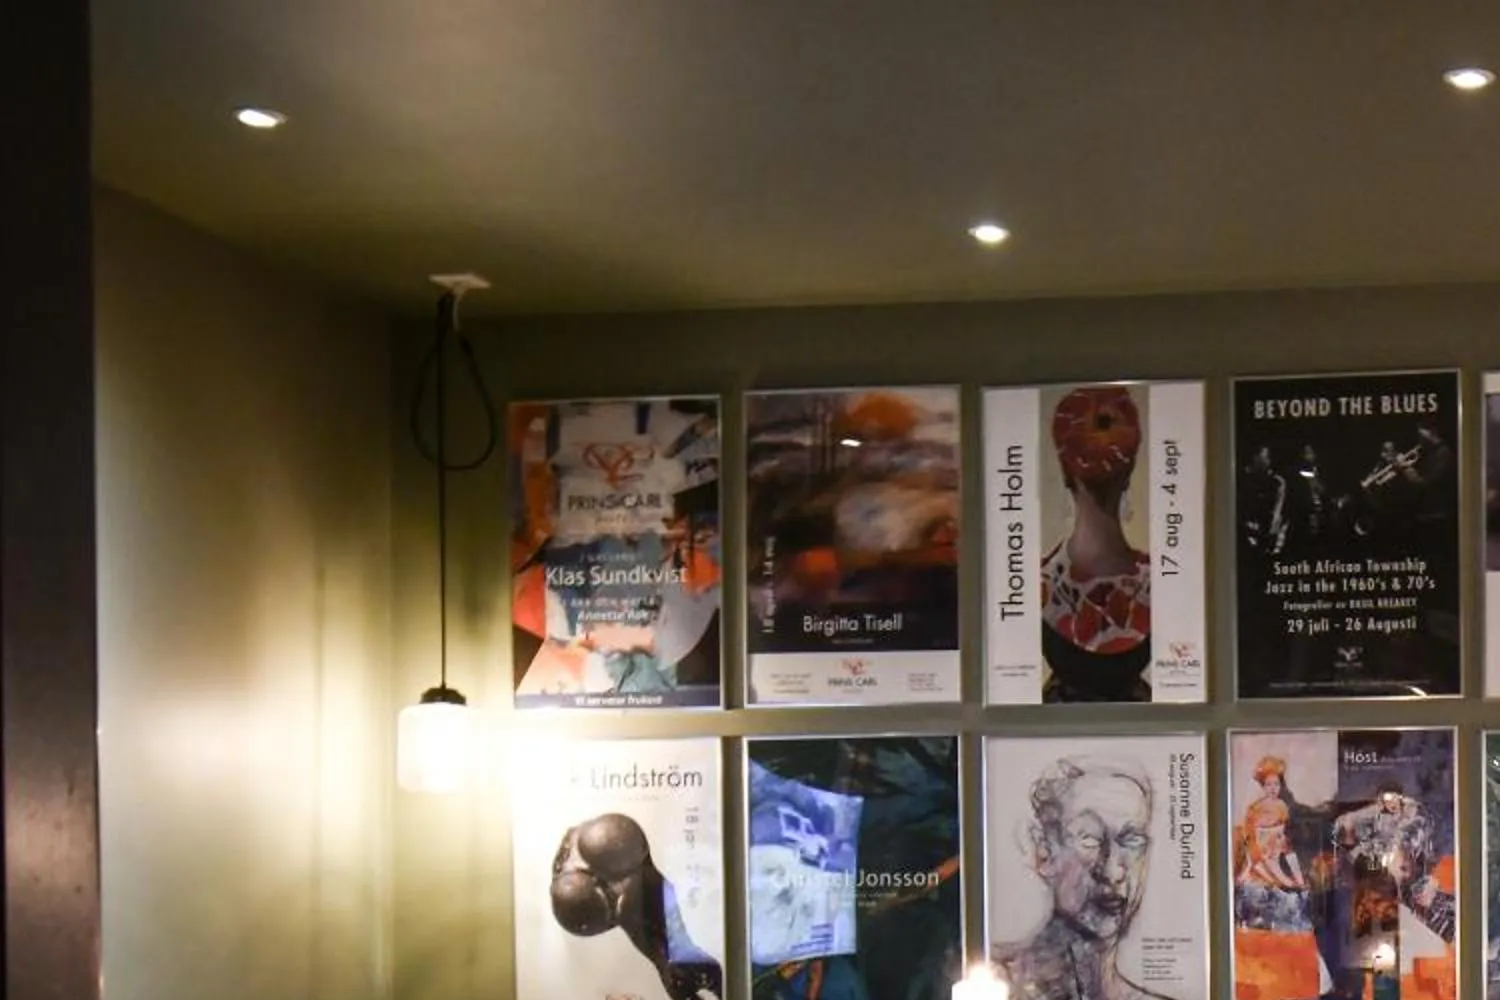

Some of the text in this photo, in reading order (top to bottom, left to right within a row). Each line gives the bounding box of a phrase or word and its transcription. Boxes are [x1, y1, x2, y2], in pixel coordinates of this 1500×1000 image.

[1253, 393, 1438, 419] BEYOND THE BLUES
[1163, 439, 1182, 476] sept
[1161, 483, 1177, 496] 4
[997, 445, 1025, 622] Thomas Holm
[1166, 512, 1184, 548] aug
[545, 564, 689, 586] Klas Sundkvist
[1160, 554, 1180, 577] 17
[1273, 557, 1427, 576] South African Township
[1265, 581, 1294, 595] Jazz
[1297, 579, 1311, 593] in
[1315, 578, 1337, 593] the
[1342, 577, 1386, 592] 1960's
[1407, 575, 1437, 590] 70's
[803, 612, 903, 637] Birgitta Tisell
[1287, 618, 1304, 633] 29
[1307, 618, 1330, 636] juli
[1344, 617, 1363, 632] 26
[1366, 615, 1418, 634] Augusti
[590, 762, 704, 789] Lindström
[1179, 752, 1196, 880] Susanne Durlind
[856, 869, 939, 888] Jonsson
